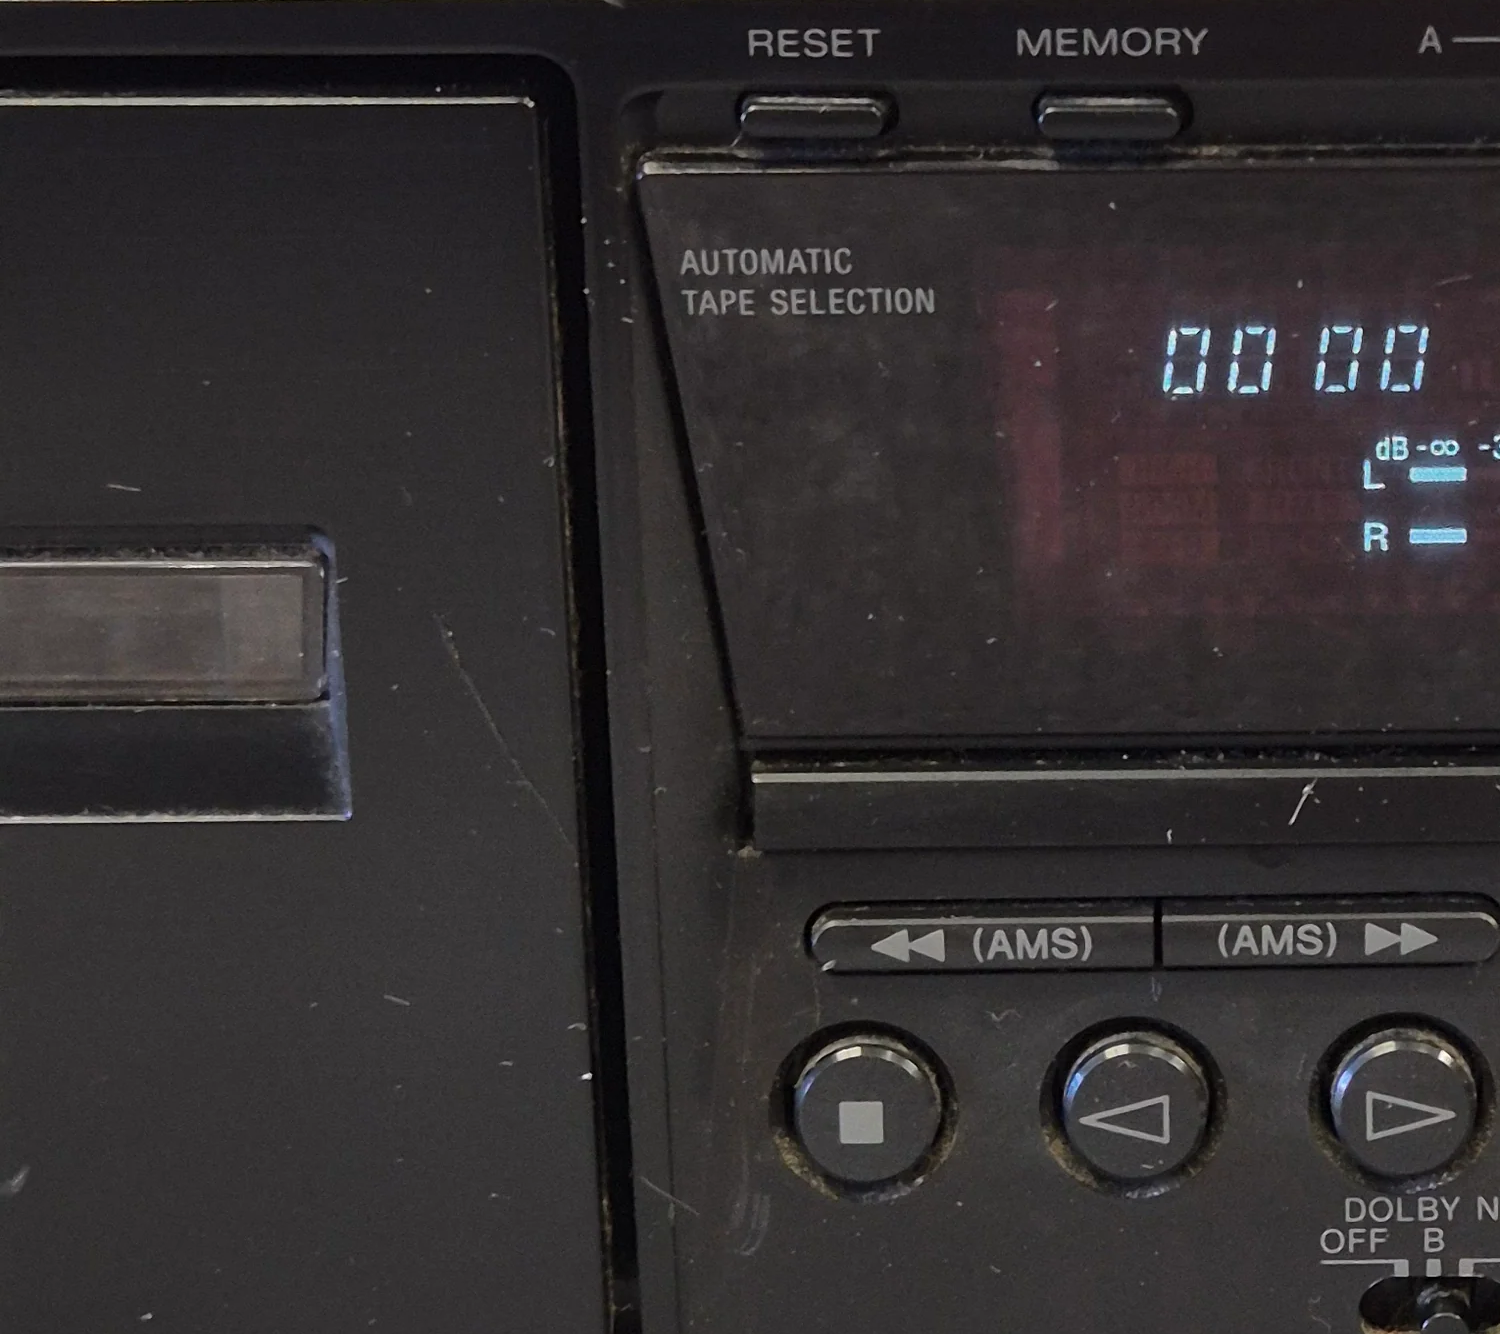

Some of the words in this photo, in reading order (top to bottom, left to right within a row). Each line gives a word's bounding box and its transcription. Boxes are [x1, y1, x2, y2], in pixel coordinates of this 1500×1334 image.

[748, 28, 881, 58] RESET
[1016, 27, 1209, 57] MEMORY
[1418, 25, 1442, 54] A
[680, 247, 853, 276] AUTOMATIC
[681, 289, 755, 316] TAPE
[769, 287, 935, 316] SELECTION
[1375, 435, 1409, 461] dB
[1363, 459, 1386, 490] L
[1363, 521, 1389, 552] R
[971, 923, 1093, 963] (AMS)
[1217, 920, 1338, 959] (AMS)
[1344, 1196, 1461, 1223] DOLBY
[1320, 1227, 1388, 1254] OFF
[1423, 1227, 1445, 1253] B
